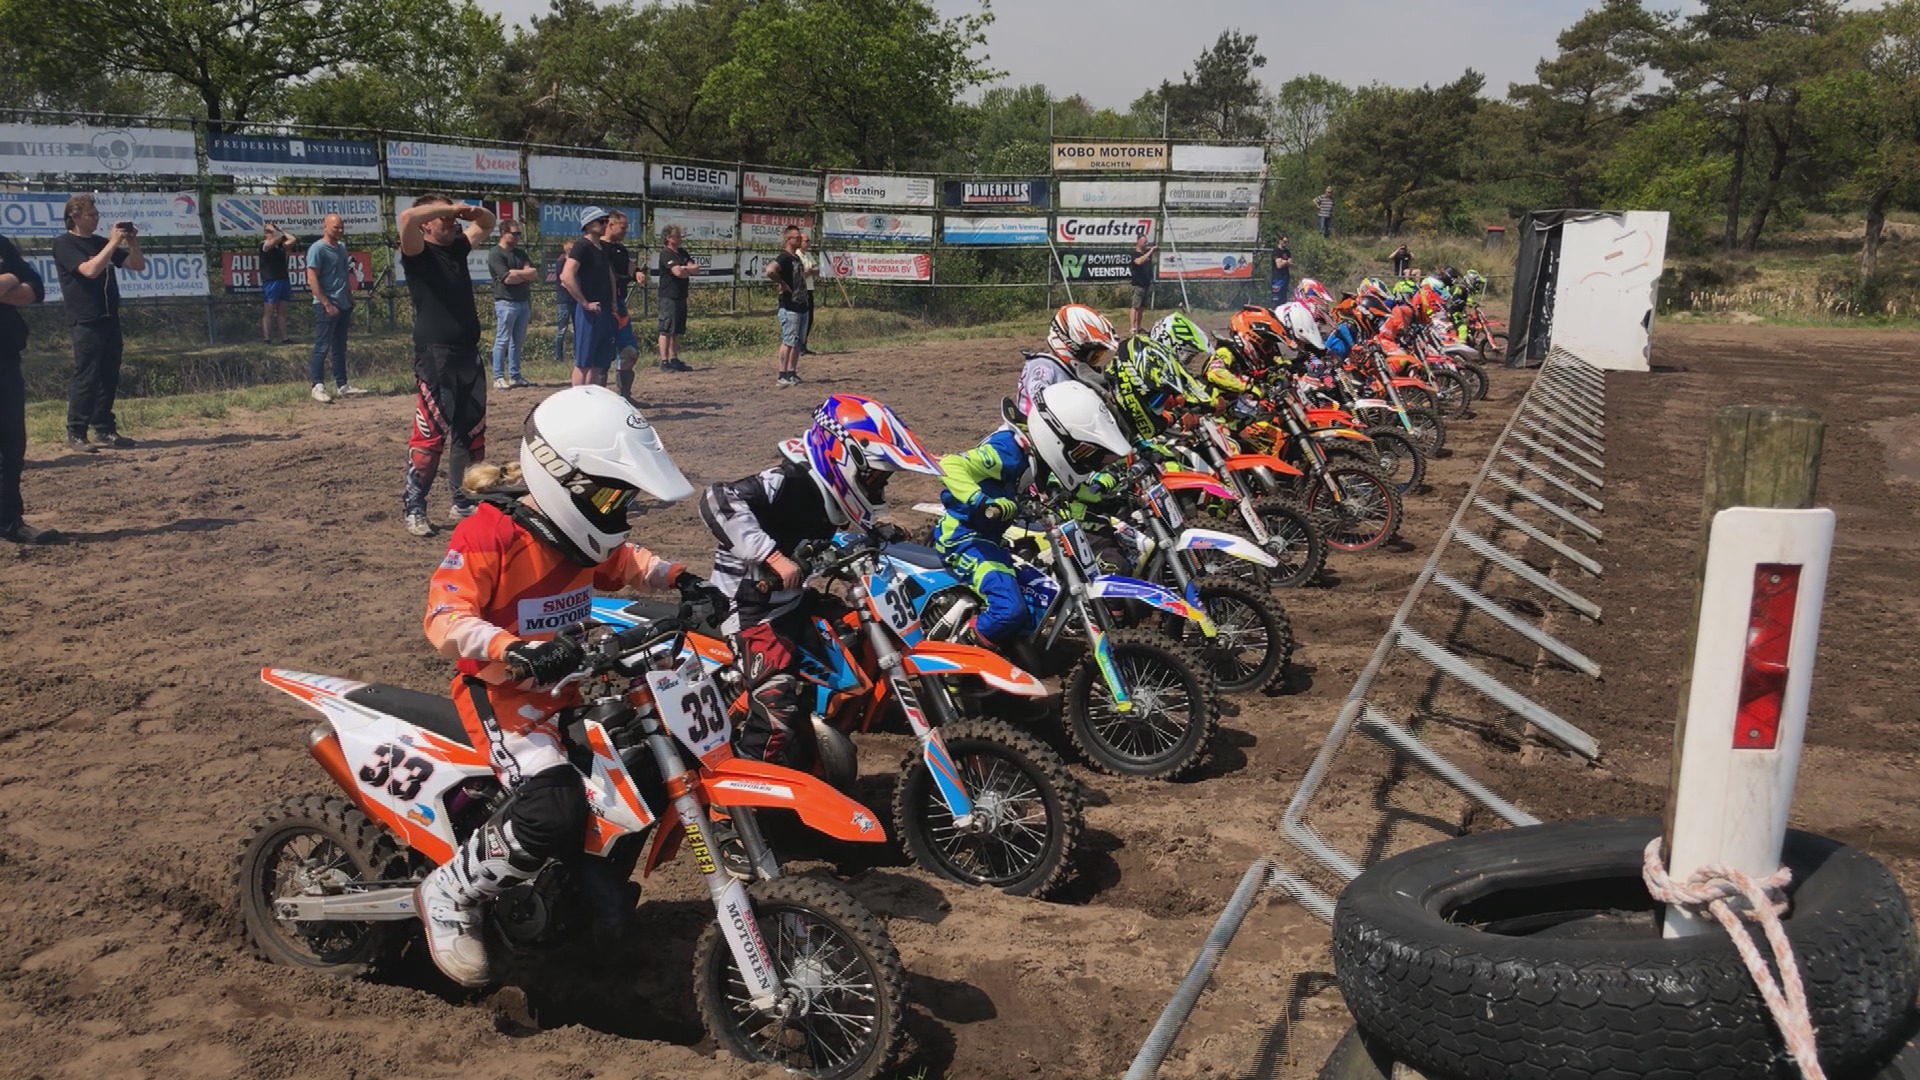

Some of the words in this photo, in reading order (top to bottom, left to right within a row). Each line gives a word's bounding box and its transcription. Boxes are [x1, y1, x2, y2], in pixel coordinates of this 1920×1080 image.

[23, 143, 70, 155] VLEES
[214, 139, 287, 150] FREDERIKS
[307, 144, 372, 155] INTERIEURS
[389, 142, 427, 158] Mobil
[1057, 147, 1095, 157] KOBO
[1100, 147, 1164, 157] MOTOREN
[662, 166, 728, 185] ROBBEN
[964, 183, 1029, 202] POWERPLUS
[262, 199, 310, 215] BRUGGEN
[312, 199, 378, 215] TWEEWIELERS
[753, 215, 767, 223] TE
[771, 217, 806, 226] HUUR
[1064, 219, 1146, 235] Graafstra
[867, 265, 899, 273] RINZEMA
[1087, 267, 1133, 277] VEENSTRA
[528, 435, 594, 495] 100%
[543, 588, 590, 613] SNOEK
[885, 584, 918, 630] 39
[681, 684, 725, 743] 33
[358, 743, 435, 802] 33
[726, 902, 771, 990] MOTOREN
